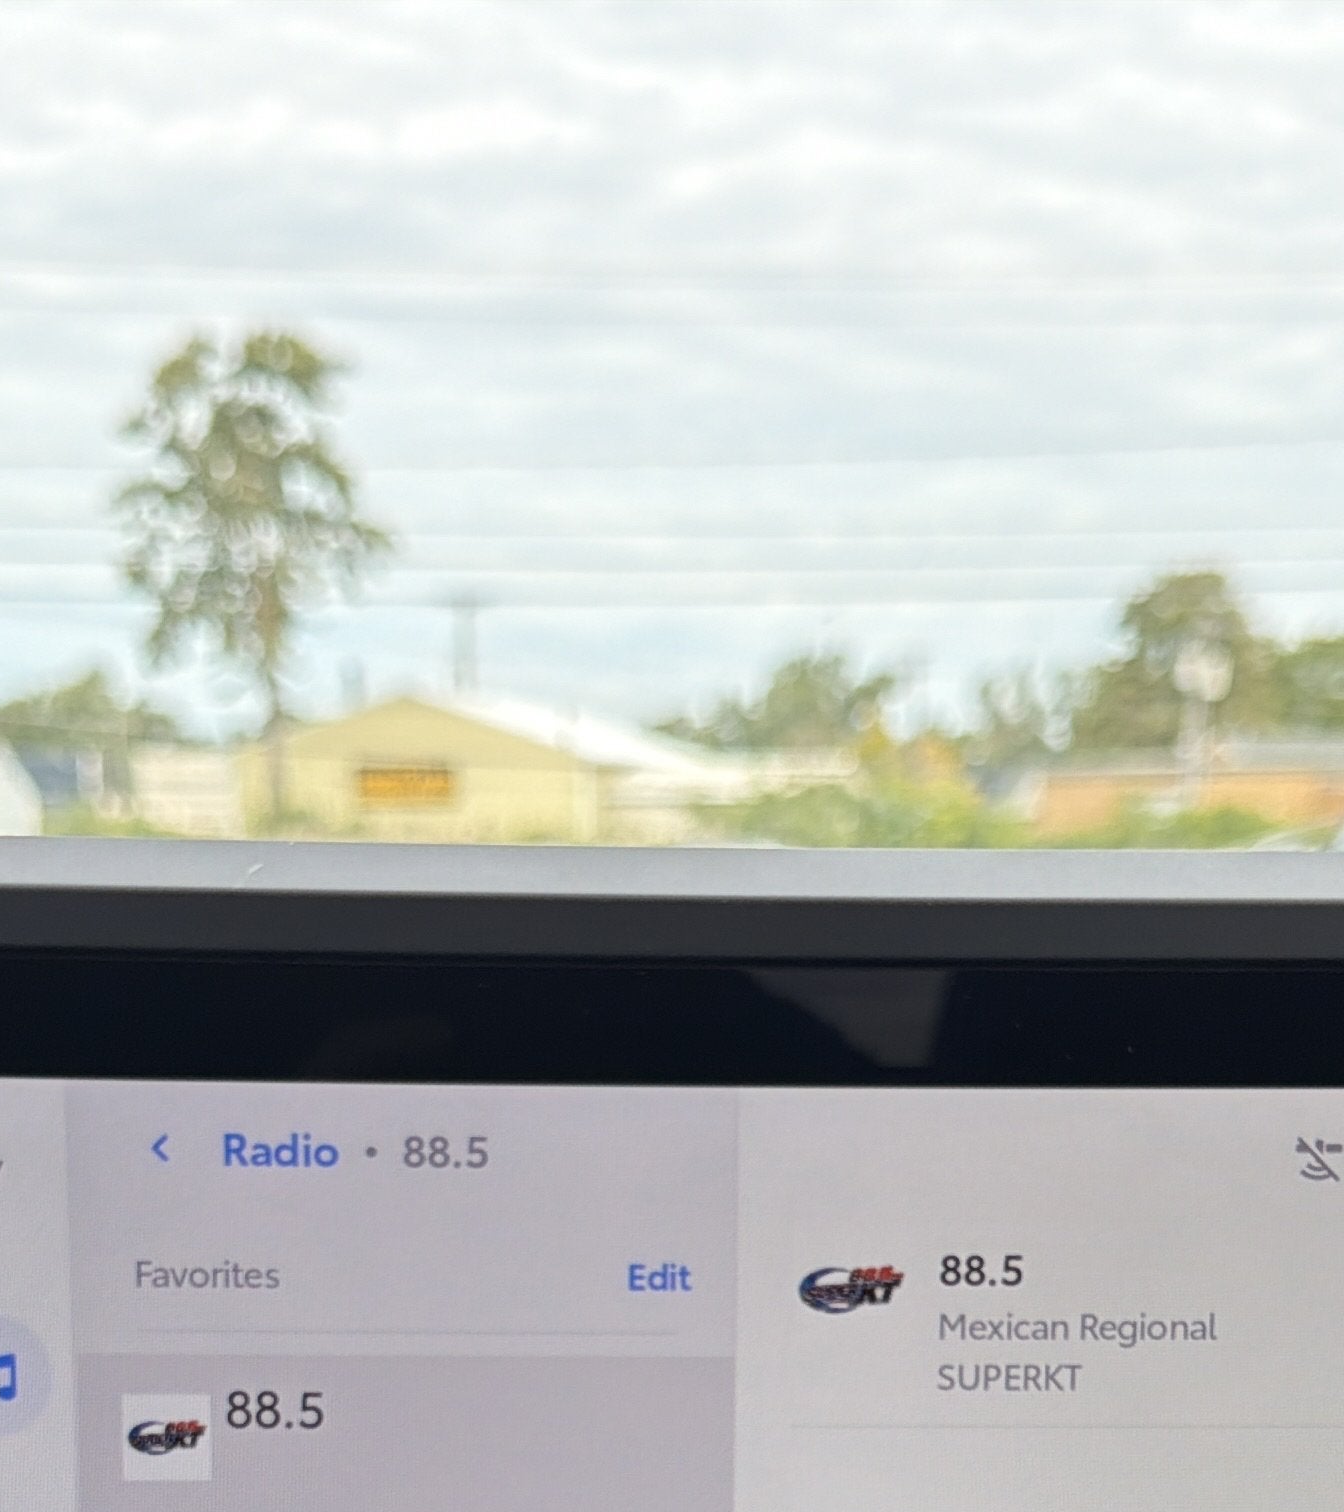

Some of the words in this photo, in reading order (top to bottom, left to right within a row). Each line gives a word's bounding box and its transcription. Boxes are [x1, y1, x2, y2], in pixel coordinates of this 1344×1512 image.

[222, 1133, 340, 1168] Radio
[403, 1136, 489, 1169] 88.5
[135, 1260, 281, 1289] Favorites
[627, 1264, 692, 1292] Edit
[940, 1255, 1024, 1288] 88.5
[938, 1312, 1069, 1342] Mexican
[1079, 1312, 1217, 1348] Regional
[937, 1364, 1083, 1392] SUPERKT
[227, 1391, 324, 1430] 88.5
